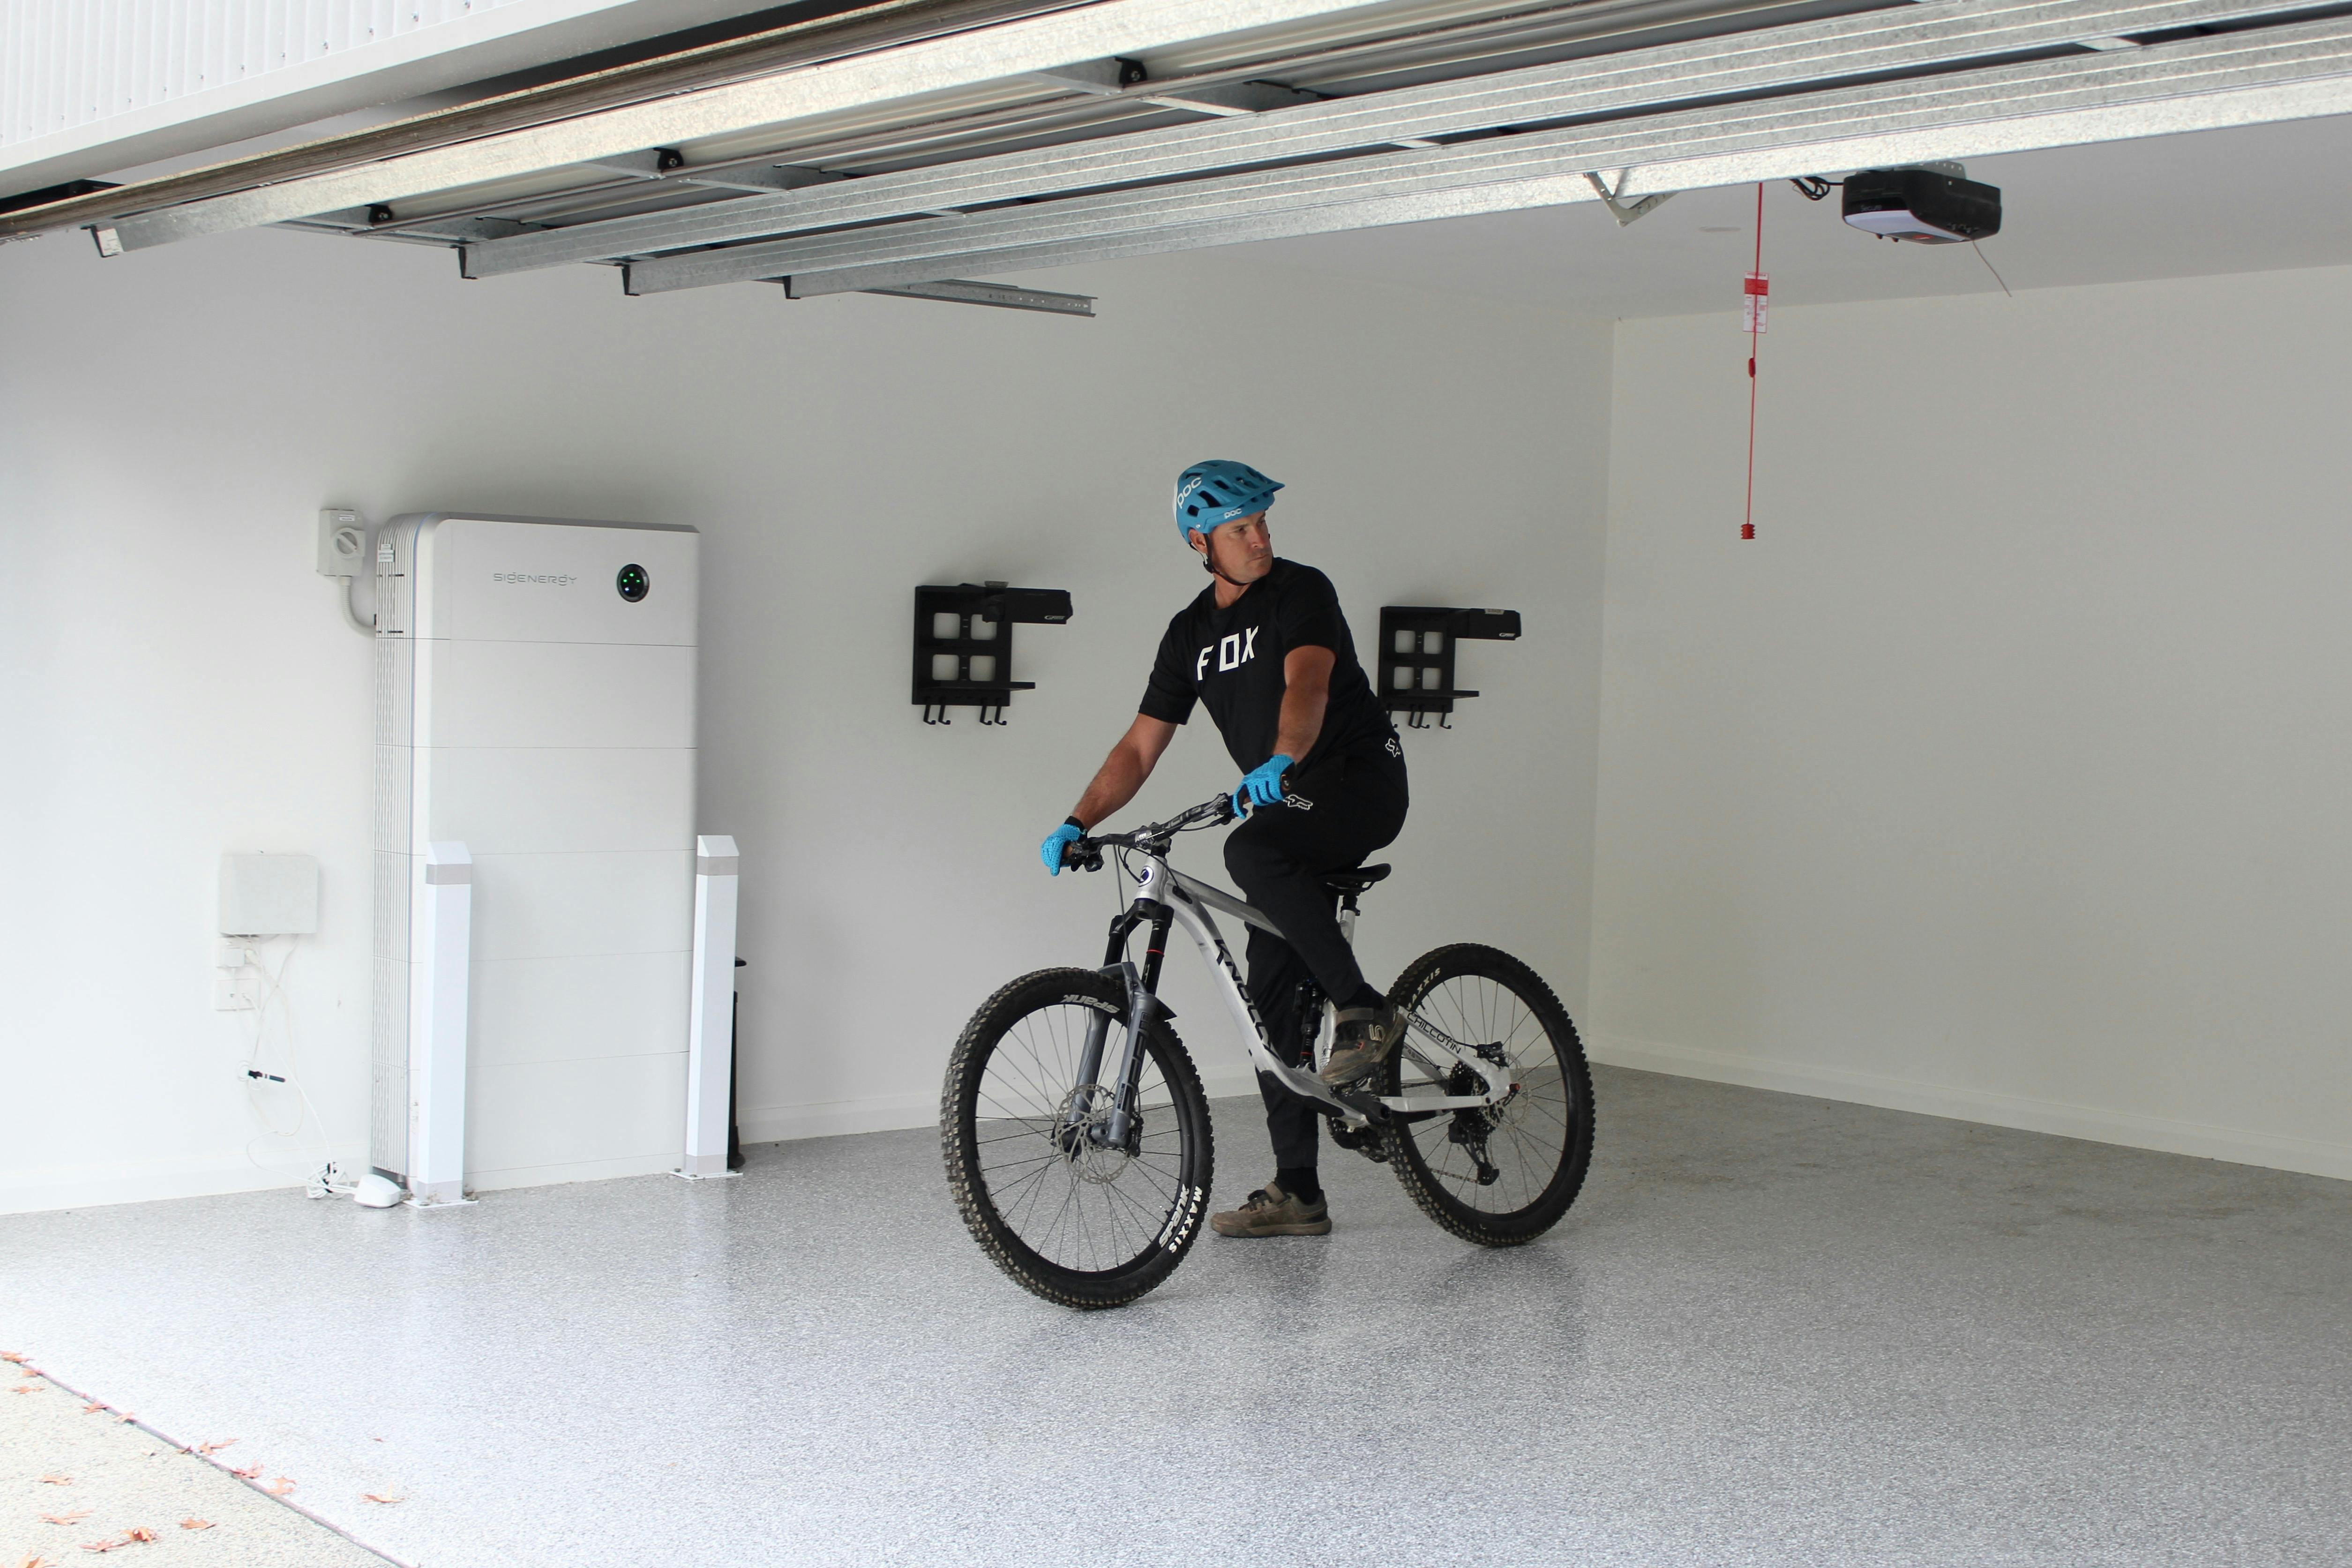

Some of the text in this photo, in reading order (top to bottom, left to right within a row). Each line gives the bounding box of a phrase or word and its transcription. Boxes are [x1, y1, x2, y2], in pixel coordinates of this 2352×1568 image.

[1197, 625, 1259, 681] FOX
[1407, 1013, 1461, 1054] CHILCOTIN
[1169, 1185, 1203, 1253] MAXXIS
